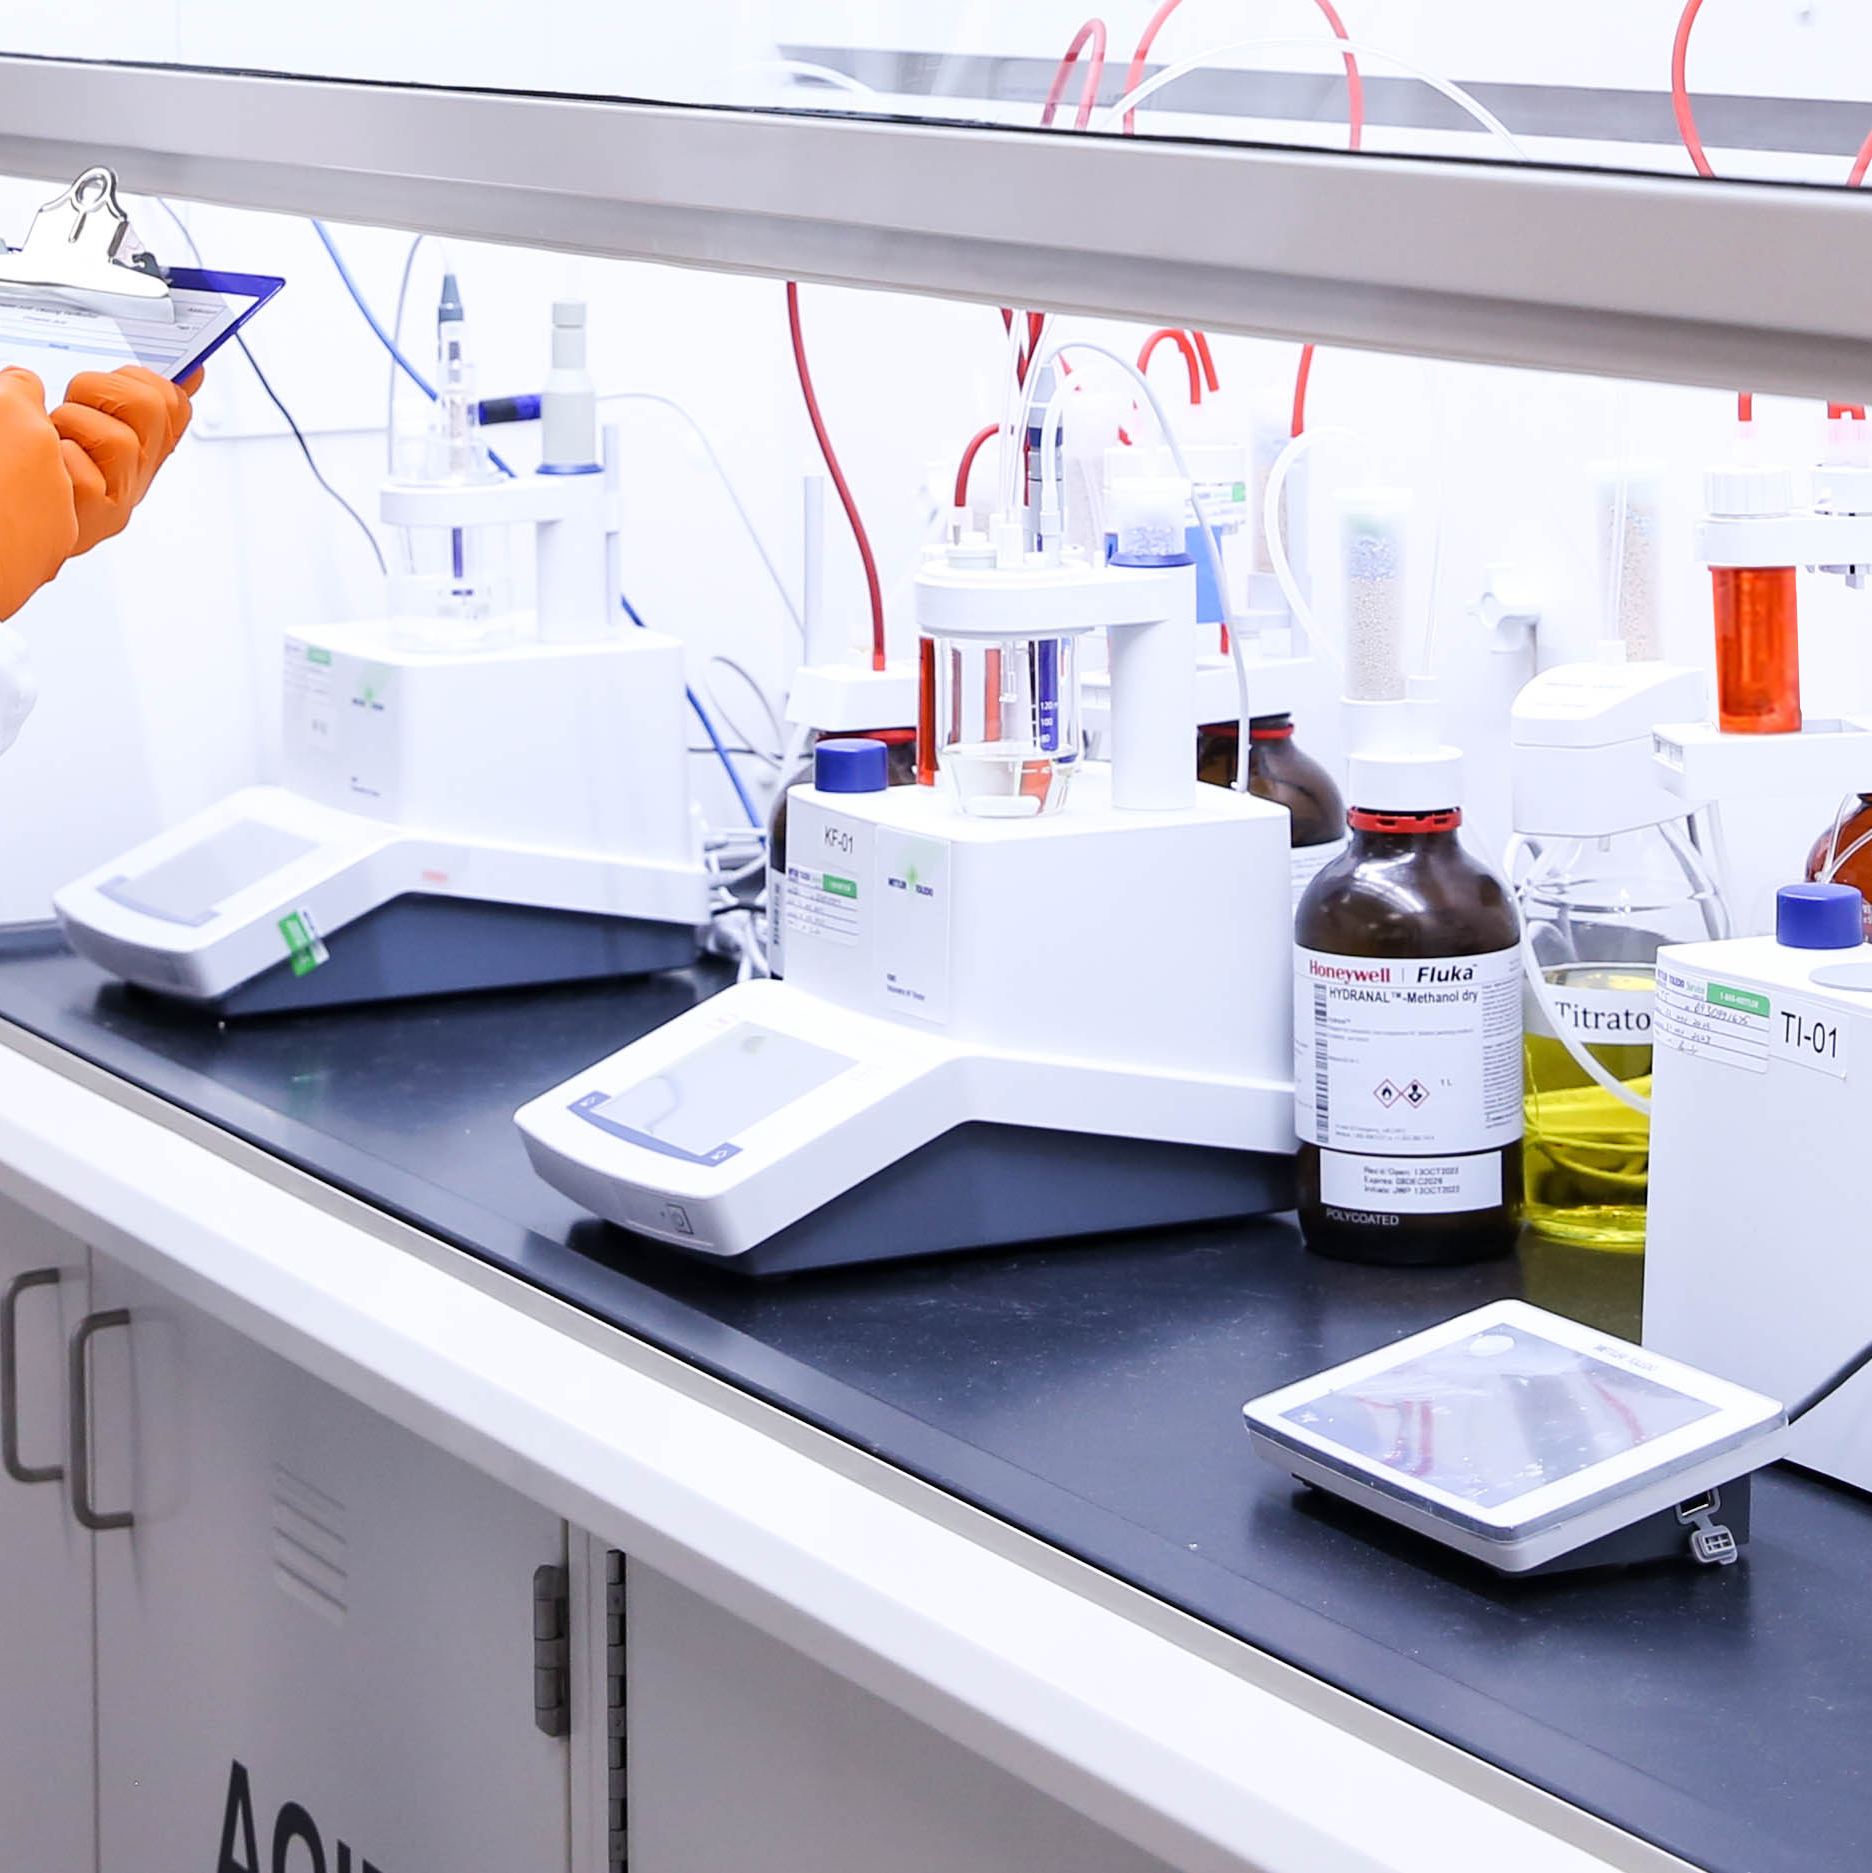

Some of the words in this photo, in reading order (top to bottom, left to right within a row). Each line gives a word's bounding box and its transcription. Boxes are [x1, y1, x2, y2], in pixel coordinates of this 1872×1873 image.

[824, 825, 854, 854] KF-01
[1309, 959, 1391, 984] Honeywell
[1462, 990, 1478, 1004] dry
[1781, 1011, 1838, 1058] TI-01
[1326, 1208, 1400, 1226] POLYCOATED
